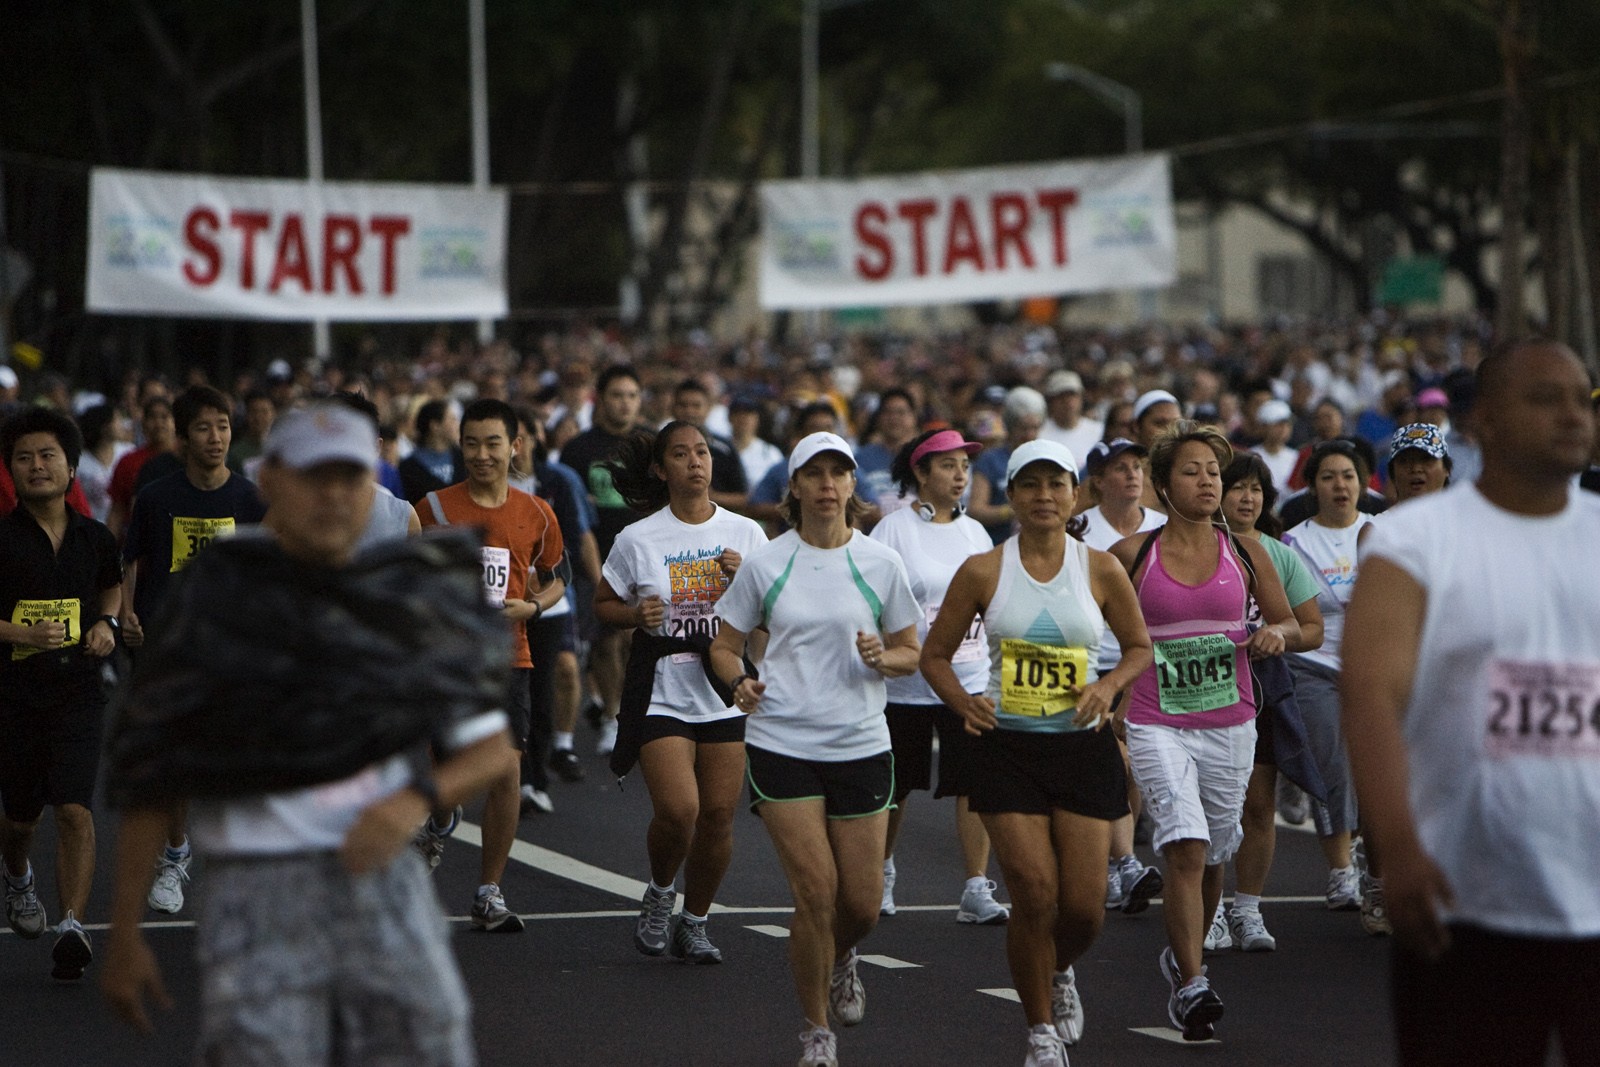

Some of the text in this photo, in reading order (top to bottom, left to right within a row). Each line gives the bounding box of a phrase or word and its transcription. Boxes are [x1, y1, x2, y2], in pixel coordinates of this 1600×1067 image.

[854, 187, 1080, 282] START
[181, 204, 412, 297] START
[697, 545, 723, 559] Marath
[18, 602, 52, 610] Hawaiian
[674, 602, 708, 610] Hawaiian
[1159, 636, 1229, 650] Hawaiian Telcom
[1059, 650, 1075, 660] Run
[1167, 650, 1186, 658] Great
[1209, 645, 1223, 654] Run
[1013, 659, 1077, 691] 1053
[1158, 653, 1233, 689] 11045
